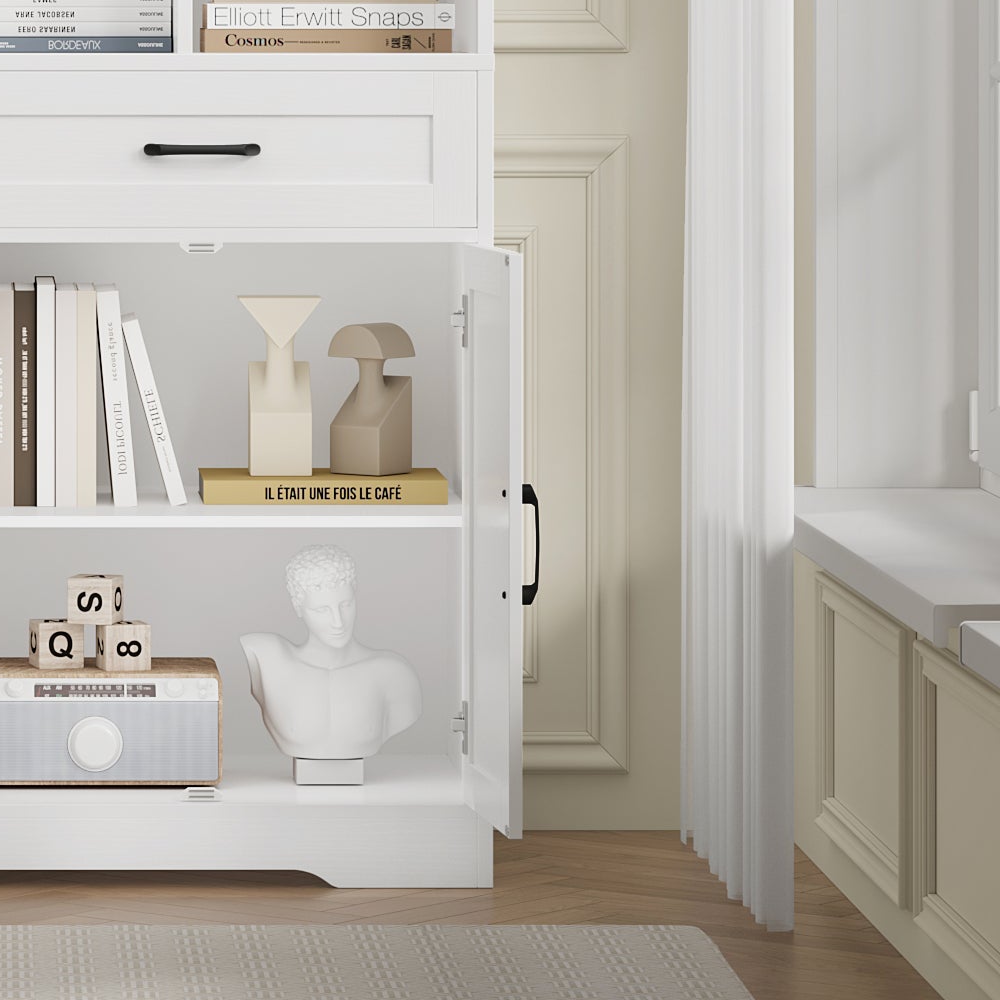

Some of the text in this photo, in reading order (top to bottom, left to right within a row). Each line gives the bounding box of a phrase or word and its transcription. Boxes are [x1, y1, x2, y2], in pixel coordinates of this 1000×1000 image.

[214, 7, 424, 29] Elliott Erwitt Snaps
[225, 34, 284, 47] Cosmos
[265, 485, 401, 499] IL ÉTAIT UNE FOIS LE CAFÉ
[77, 592, 102, 612] S
[49, 632, 73, 659] Q
[117, 641, 141, 657] 8
